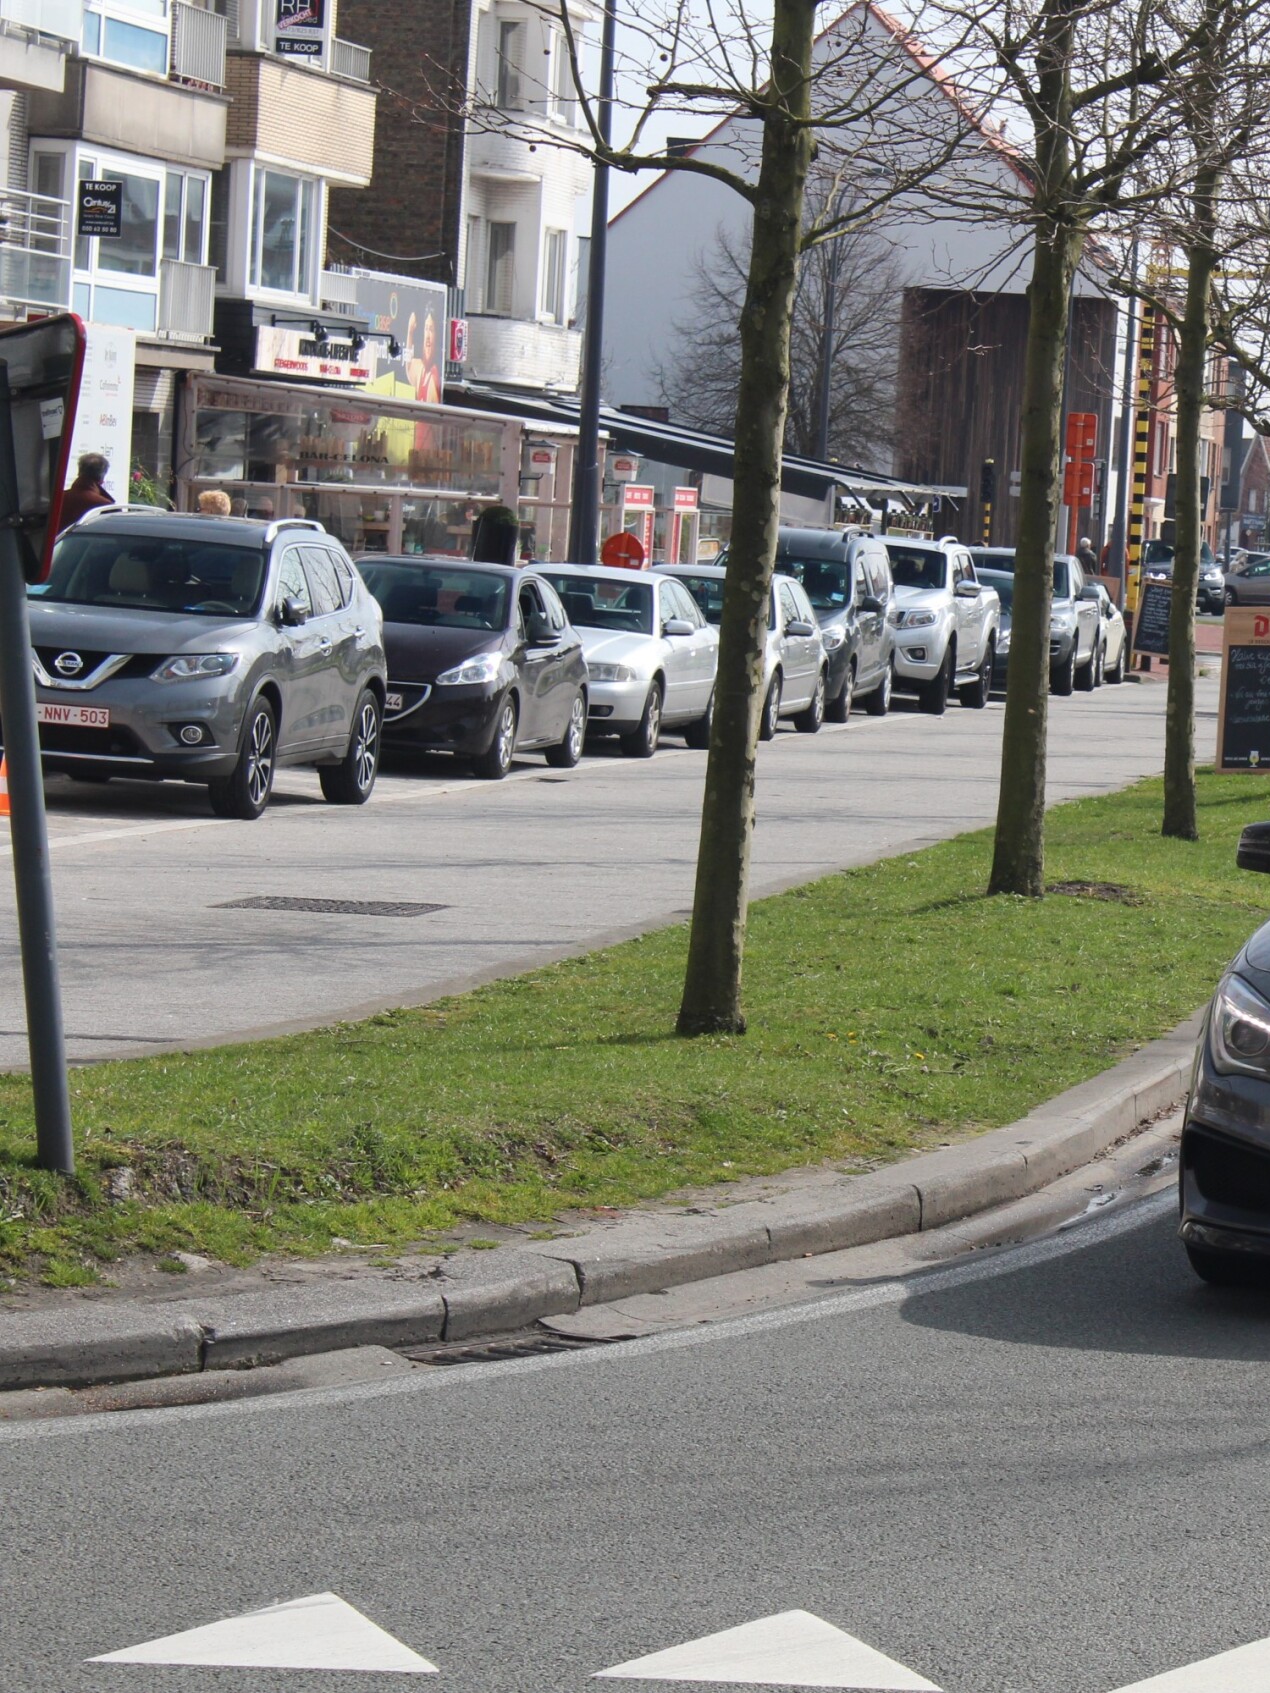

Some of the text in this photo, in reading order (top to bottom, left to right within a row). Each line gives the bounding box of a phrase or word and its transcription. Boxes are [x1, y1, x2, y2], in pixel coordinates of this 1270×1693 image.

[280, 41, 319, 53] TE KOOP
[299, 450, 389, 464] BAR-CELONA
[386, 696, 400, 707] 44
[38, 706, 107, 724] -NNV-503
